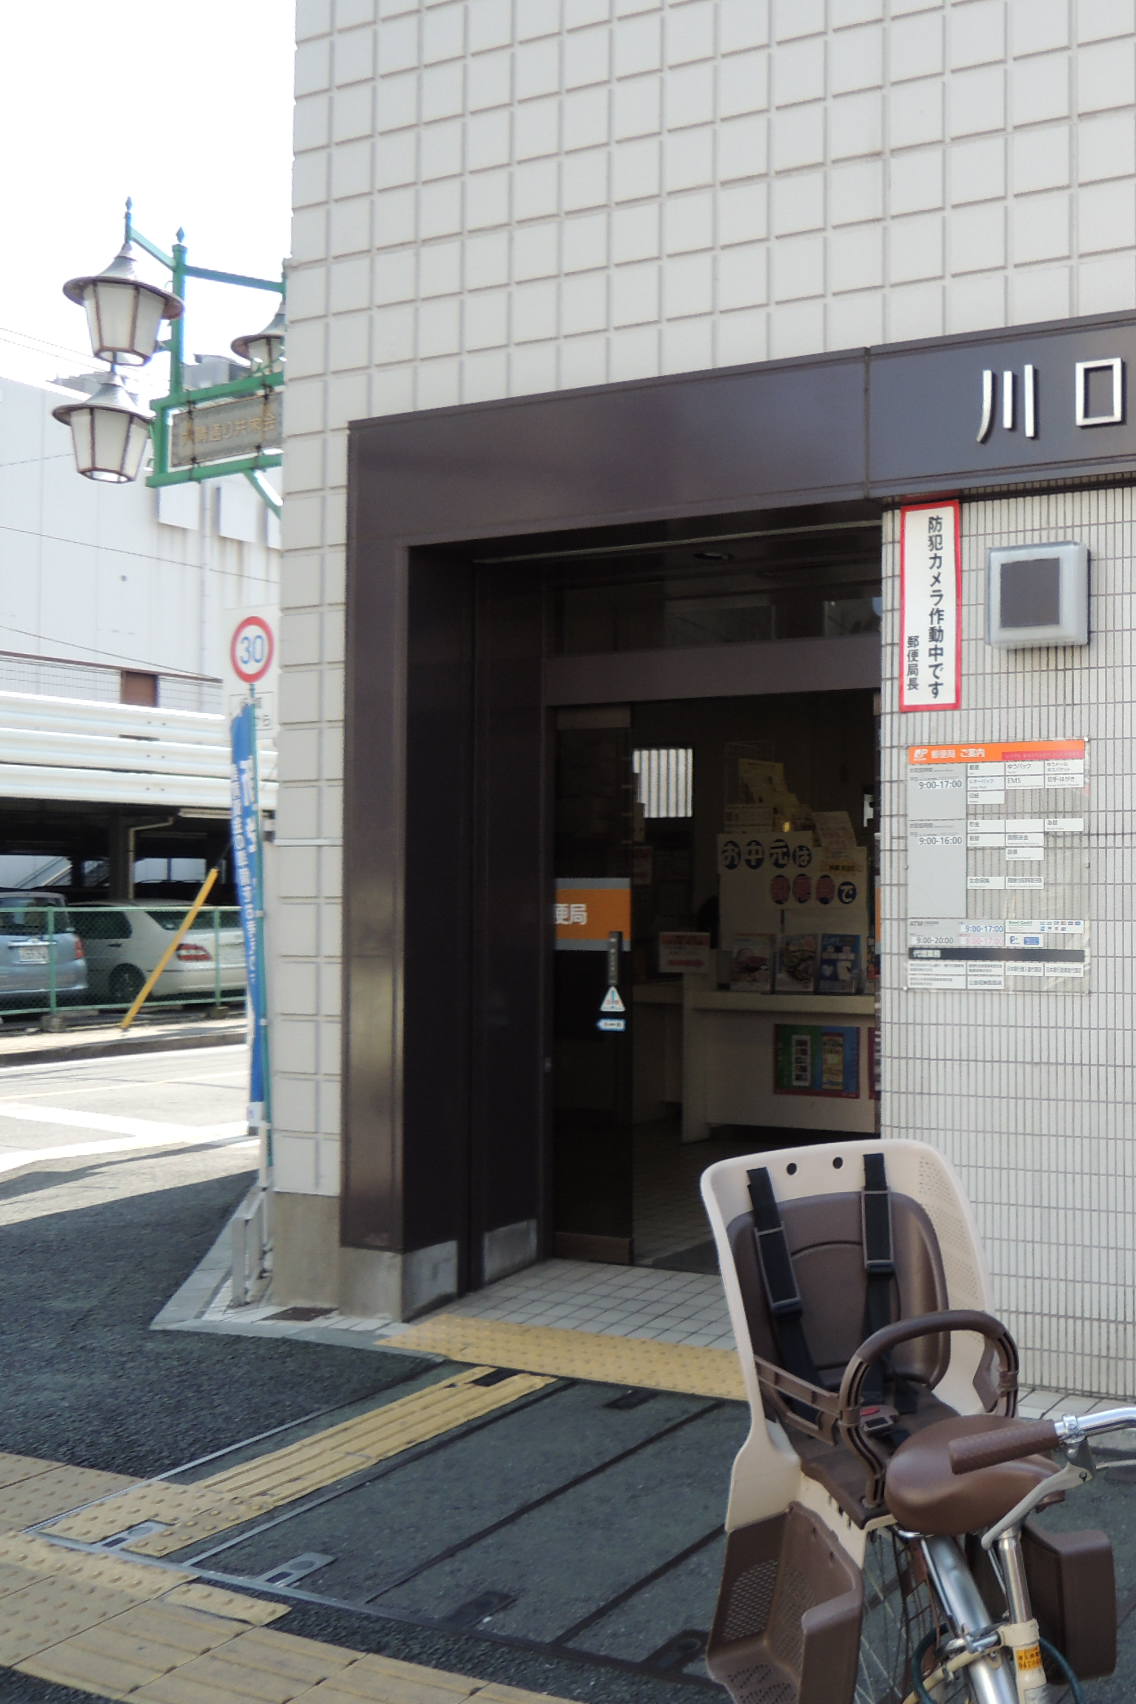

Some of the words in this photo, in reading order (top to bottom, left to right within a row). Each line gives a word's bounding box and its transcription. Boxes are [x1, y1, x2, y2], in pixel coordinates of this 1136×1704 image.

[927, 516, 945, 699] 防犯カメラ作動中です
[240, 634, 265, 665] 30
[906, 635, 920, 691] 郵便局長
[918, 779, 962, 790] 9:00-17:00
[919, 836, 963, 846] 9:00-16:00
